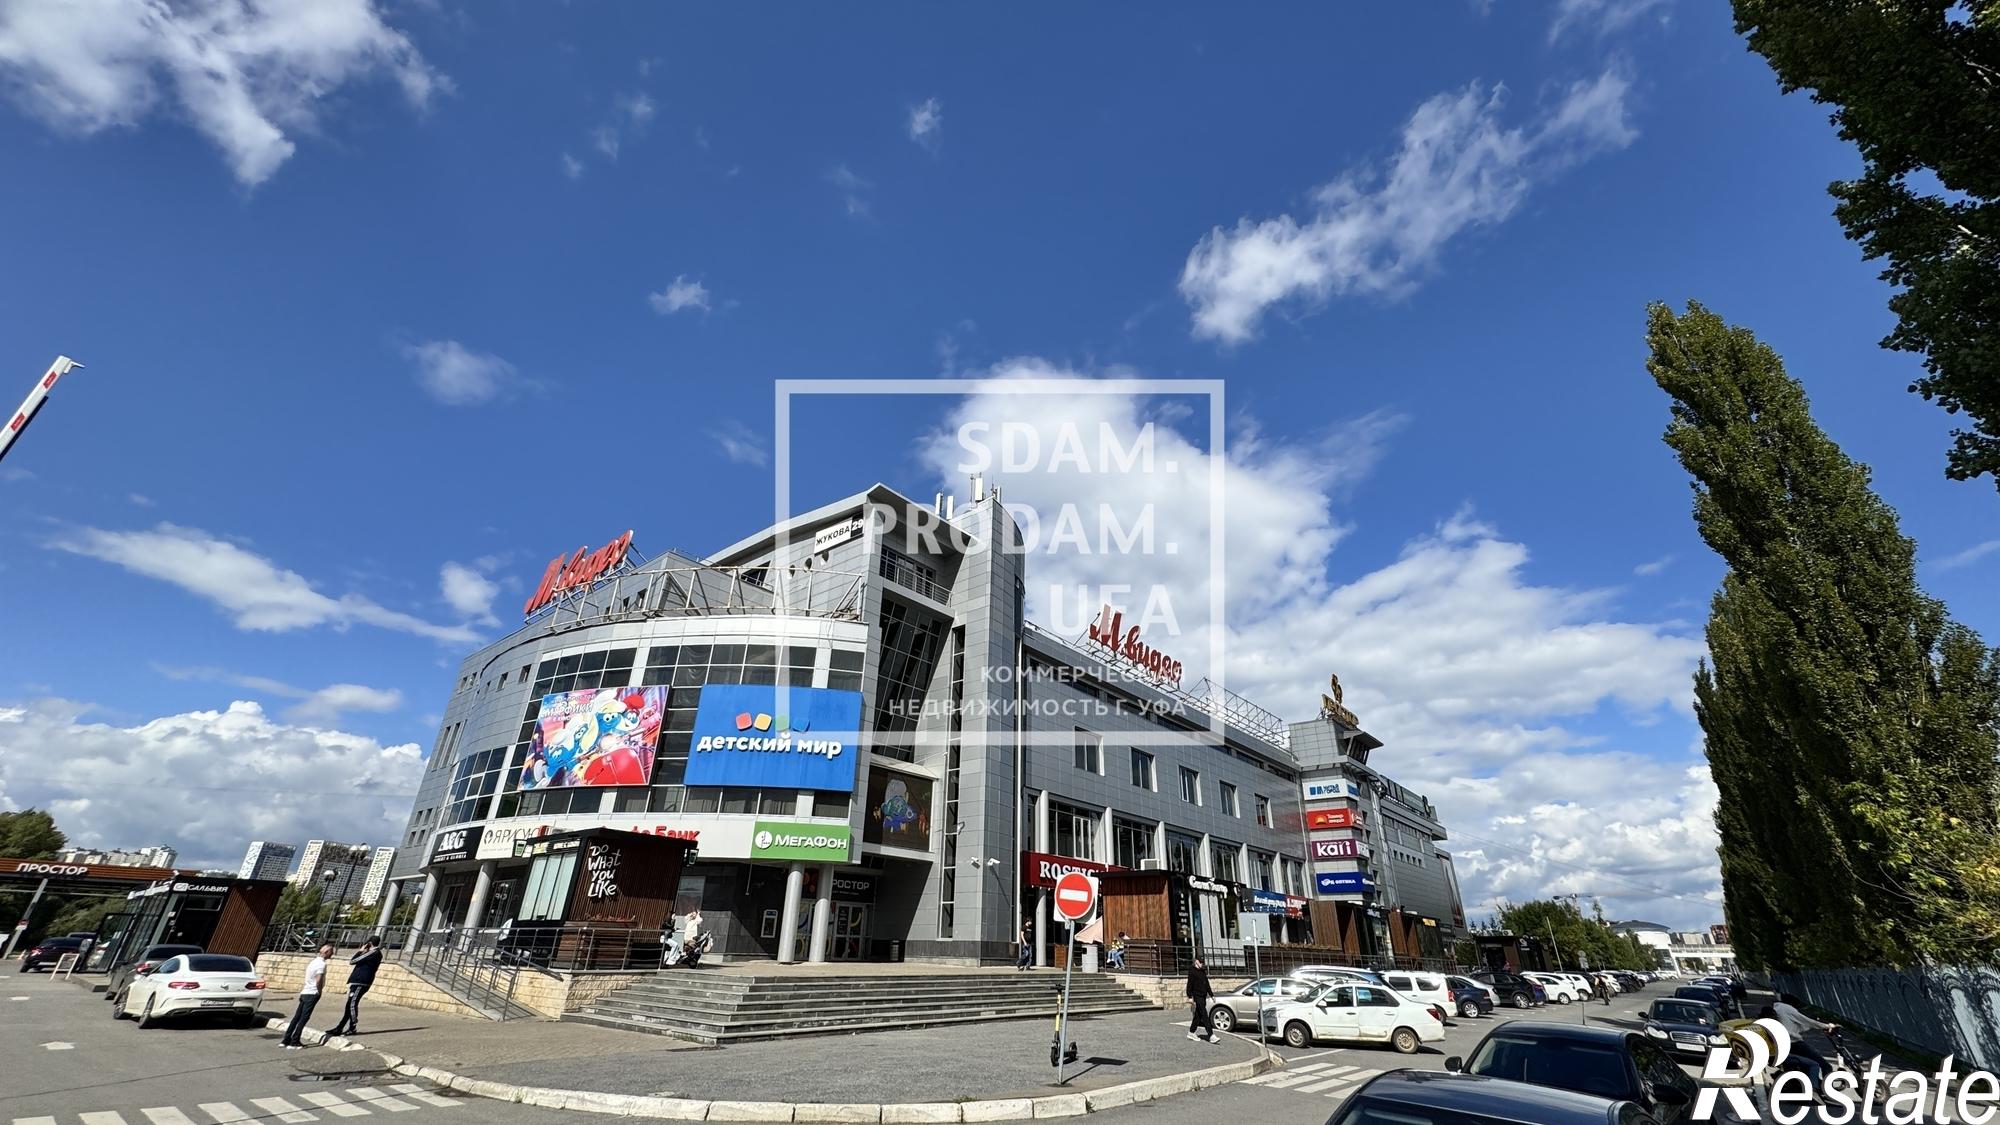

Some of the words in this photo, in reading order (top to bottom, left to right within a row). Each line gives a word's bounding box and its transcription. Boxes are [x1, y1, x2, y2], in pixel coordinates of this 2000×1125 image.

[816, 525, 850, 546] ЖУКОВА
[852, 518, 864, 531] 29
[696, 731, 791, 753] детский
[797, 740, 843, 760] мир
[655, 825, 701, 841] Банк
[1316, 841, 1352, 857] kari
[16, 862, 88, 876] ПРОСТОР
[188, 883, 229, 893] САЛЬВИЯ
[832, 879, 870, 891] РОСТОР
